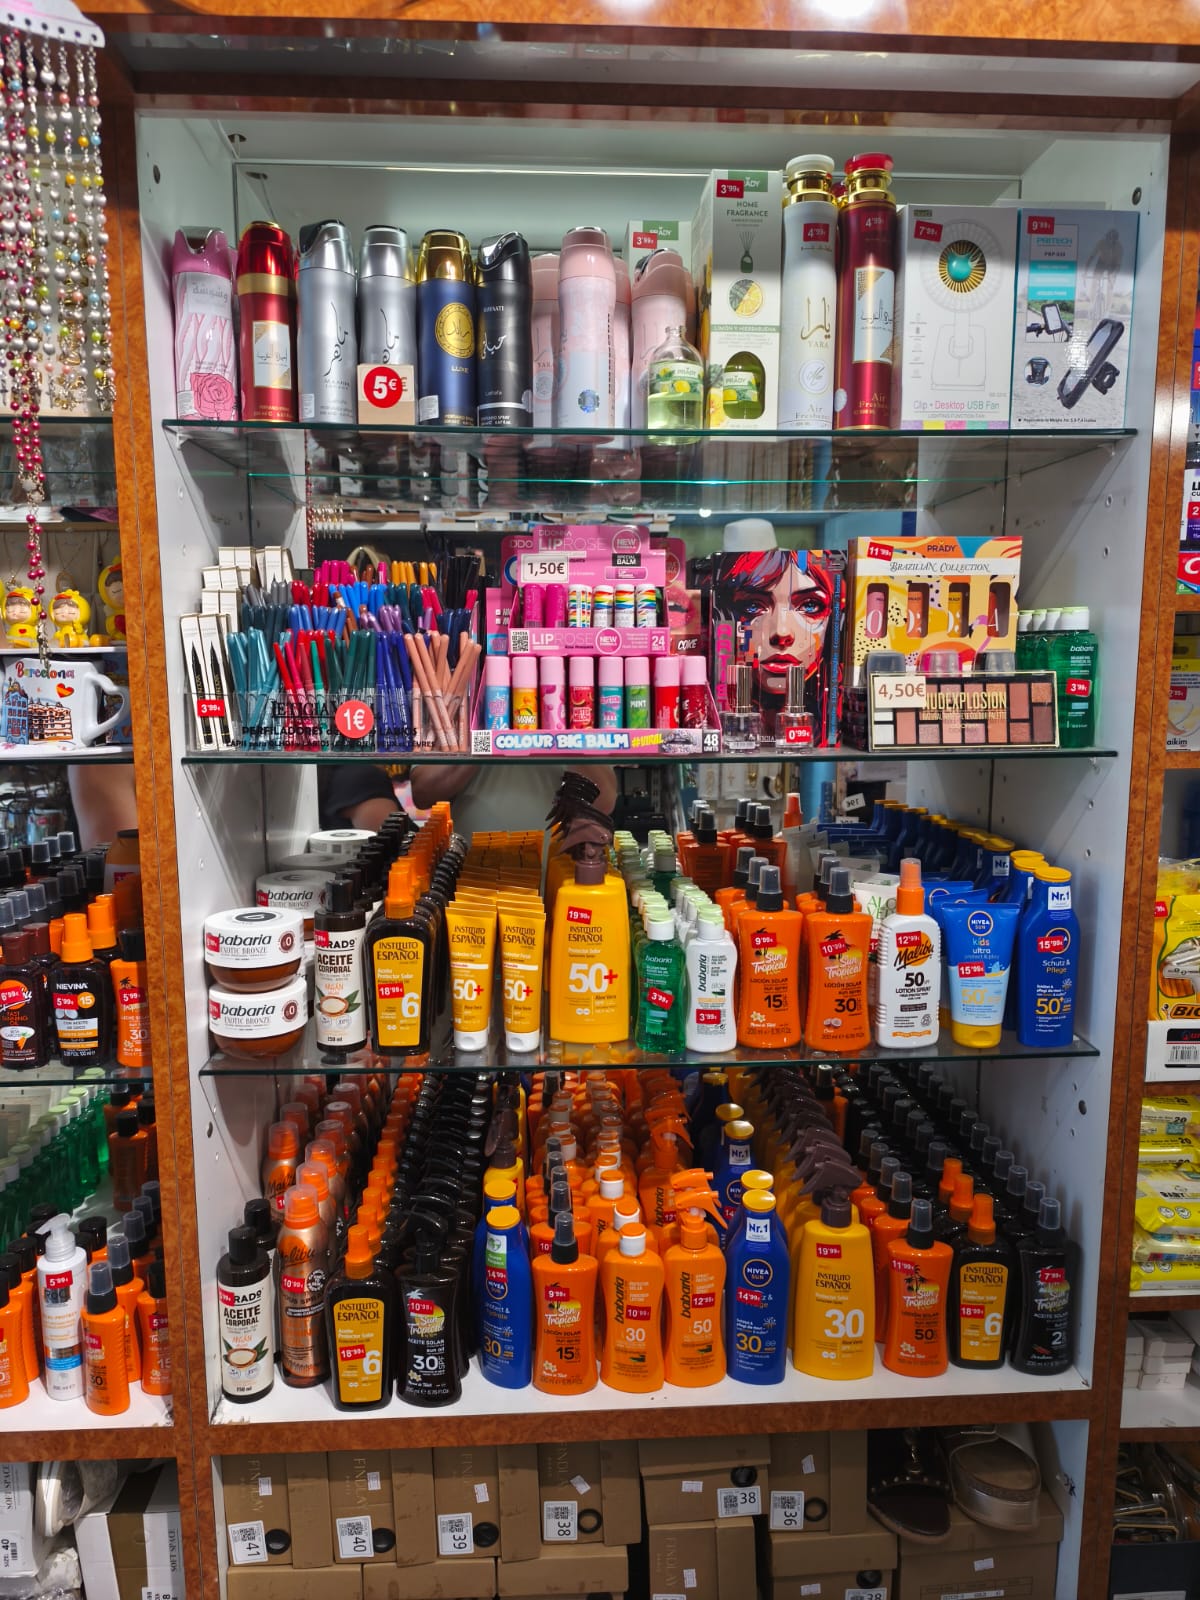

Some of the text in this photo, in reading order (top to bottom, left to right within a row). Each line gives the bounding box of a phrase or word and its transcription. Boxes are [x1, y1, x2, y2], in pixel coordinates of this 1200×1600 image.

[373, 375, 397, 398] 5€
[914, 401, 999, 411] Clip Desktop USB Fan
[927, 544, 956, 552] PRADY
[527, 562, 565, 577] 1,50€
[889, 561, 990, 572] BRAZILIAN COLLECTION
[652, 635, 665, 646] 24
[678, 637, 698, 650] COKE
[16, 661, 75, 679] Barcelona
[878, 683, 925, 698] 4,50€
[201, 703, 221, 713] 3'99€
[630, 700, 646, 709] MINT
[343, 708, 366, 731] 1€
[703, 734, 718, 746] 48
[788, 730, 810, 740] 0'99€
[495, 734, 555, 750] COLOUR
[556, 734, 582, 750] BIG
[585, 734, 629, 750] BALM
[267, 890, 313, 901] babaria
[1051, 891, 1070, 901] Nr.1
[454, 926, 486, 934] INSTITUTO
[505, 926, 535, 935] INSTITUTO
[568, 926, 602, 934] INSTITUTO
[218, 933, 272, 946] babaria
[451, 934, 486, 945] ESPAÑOL
[503, 934, 535, 946] ESPAÑOL
[568, 934, 603, 942] ESPAÑOL
[378, 942, 418, 951] INSTITUTO
[317, 954, 353, 966] ACEITE
[376, 949, 421, 960] ESPAÑOL
[645, 955, 673, 964] babaria
[766, 952, 783, 963] Sun
[894, 942, 934, 971] Malibu
[751, 961, 788, 973] Tropical
[839, 957, 857, 966] Sun
[318, 965, 351, 973] CORPORAL
[698, 954, 707, 992] babaria
[824, 965, 862, 980] Tropical
[568, 962, 618, 993] 50+
[904, 973, 925, 988] 50
[453, 980, 484, 1001] 50+
[504, 980, 533, 1002] 50+
[401, 992, 420, 1018] 6
[764, 994, 783, 1009] 15
[834, 998, 857, 1013] 30
[221, 1004, 276, 1016] babaria
[130, 1029, 147, 1040] 30
[748, 1223, 769, 1233] Nr.1
[747, 1267, 769, 1275] NIVEA
[965, 1266, 1003, 1275] INSTITUTO
[817, 1272, 851, 1282] INSTITUTO
[963, 1273, 1004, 1284] ESPAÑOL
[815, 1279, 852, 1290] ESPAÑOL
[680, 1272, 690, 1318] babaria
[916, 1288, 933, 1298] Sun
[1048, 1290, 1065, 1299] Sun
[614, 1276, 626, 1323] babaria
[902, 1295, 938, 1307] Tropical
[1034, 1296, 1069, 1311] Tropical
[223, 1305, 261, 1318] ACEITE
[339, 1302, 378, 1312] INSTITUTO
[558, 1307, 576, 1316] Sun
[337, 1310, 380, 1322] ESPAÑOL
[420, 1315, 437, 1325] Sun
[544, 1314, 580, 1325] Tropical
[226, 1318, 259, 1327] CORPORAL
[692, 1319, 712, 1335] 50
[823, 1308, 865, 1339] 30
[984, 1312, 1001, 1336] 6
[408, 1324, 444, 1336] Tropical
[625, 1328, 645, 1342] 30
[914, 1329, 935, 1340] 50
[735, 1333, 762, 1353] 30
[1051, 1331, 1062, 1345] 2
[483, 1335, 501, 1358] 30
[555, 1347, 575, 1360] 15
[362, 1350, 381, 1376] 6
[413, 1355, 438, 1370] 30
[90, 1375, 103, 1385] 30
[739, 1491, 757, 1505] 38
[783, 1509, 798, 1526] 36
[557, 1520, 571, 1537] 38
[1, 1539, 10, 1550] 40
[352, 1535, 367, 1554] 40
[452, 1533, 467, 1551] 39
[245, 1541, 261, 1558] 41
